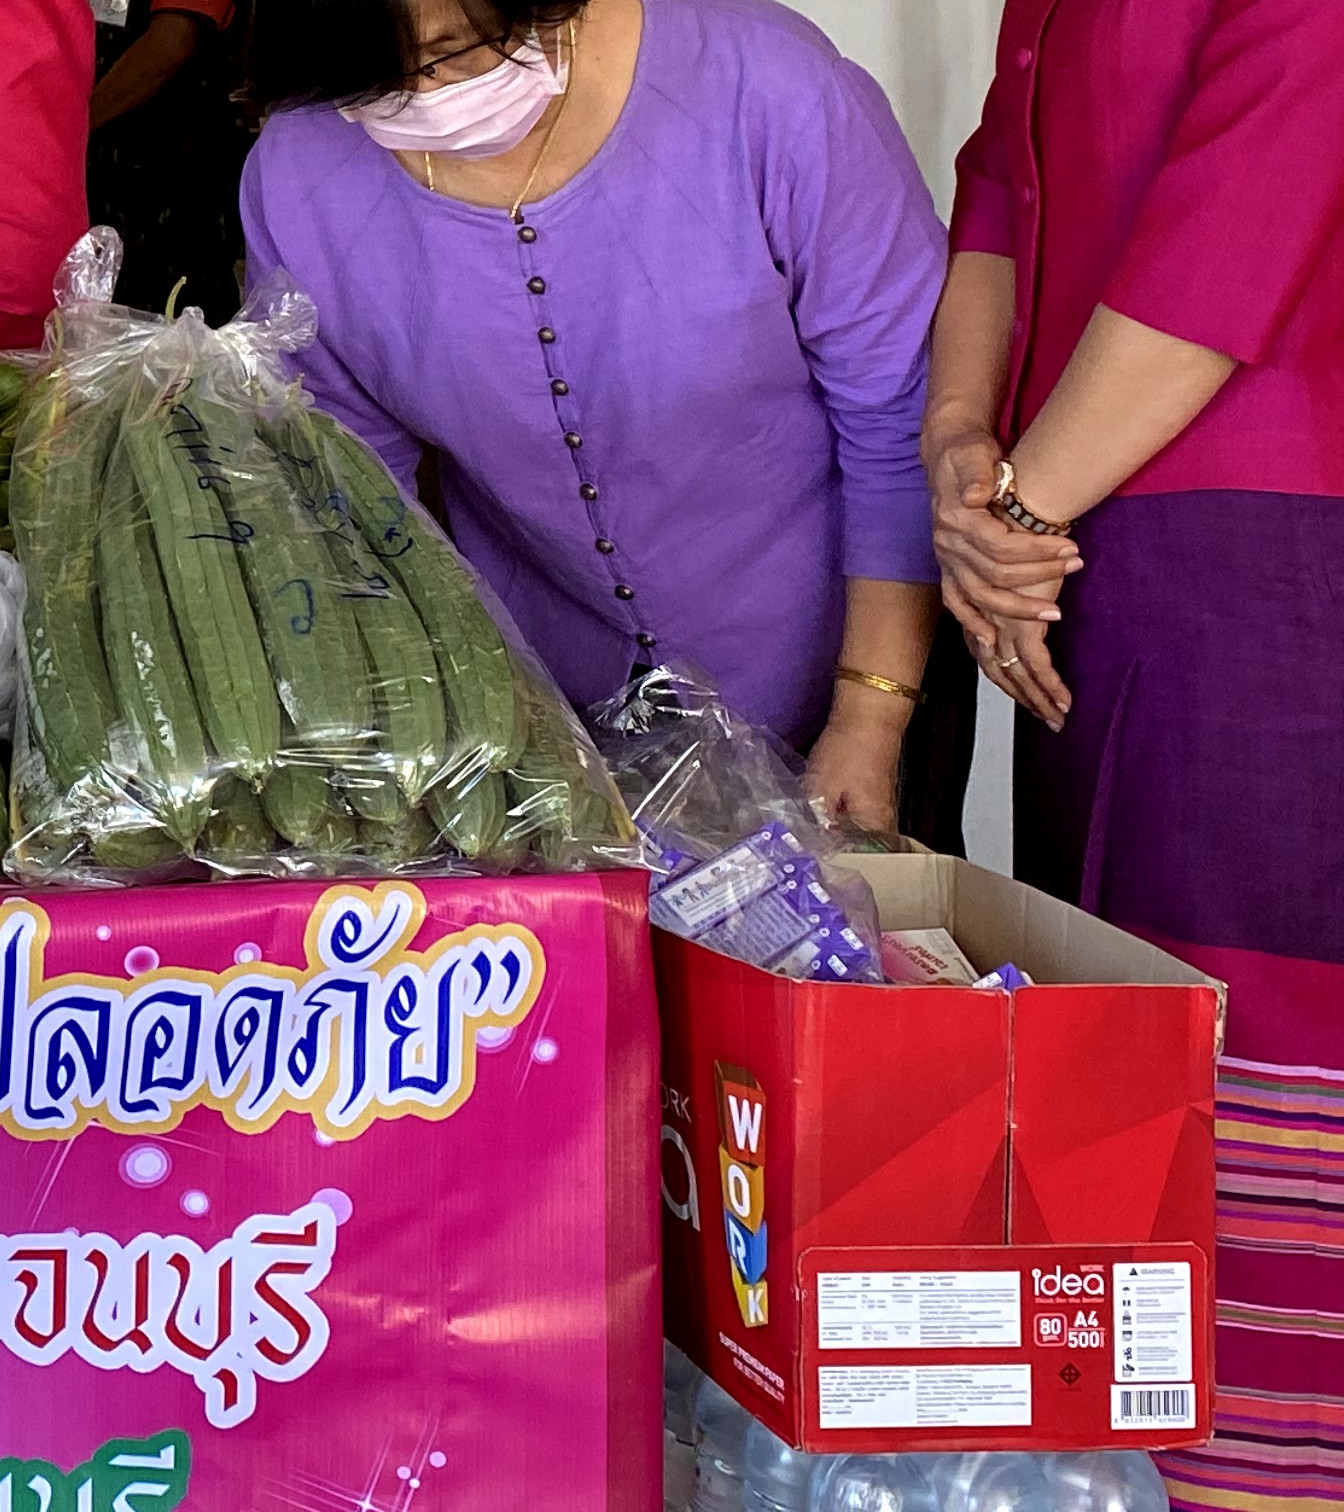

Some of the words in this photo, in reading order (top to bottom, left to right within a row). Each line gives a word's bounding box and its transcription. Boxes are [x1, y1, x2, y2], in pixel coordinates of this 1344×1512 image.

[726, 1093, 765, 1325] WORK
[1031, 1264, 1105, 1297] idea
[1039, 1318, 1062, 1335] 80
[1073, 1310, 1100, 1328] A4
[1068, 1331, 1100, 1349] 500
